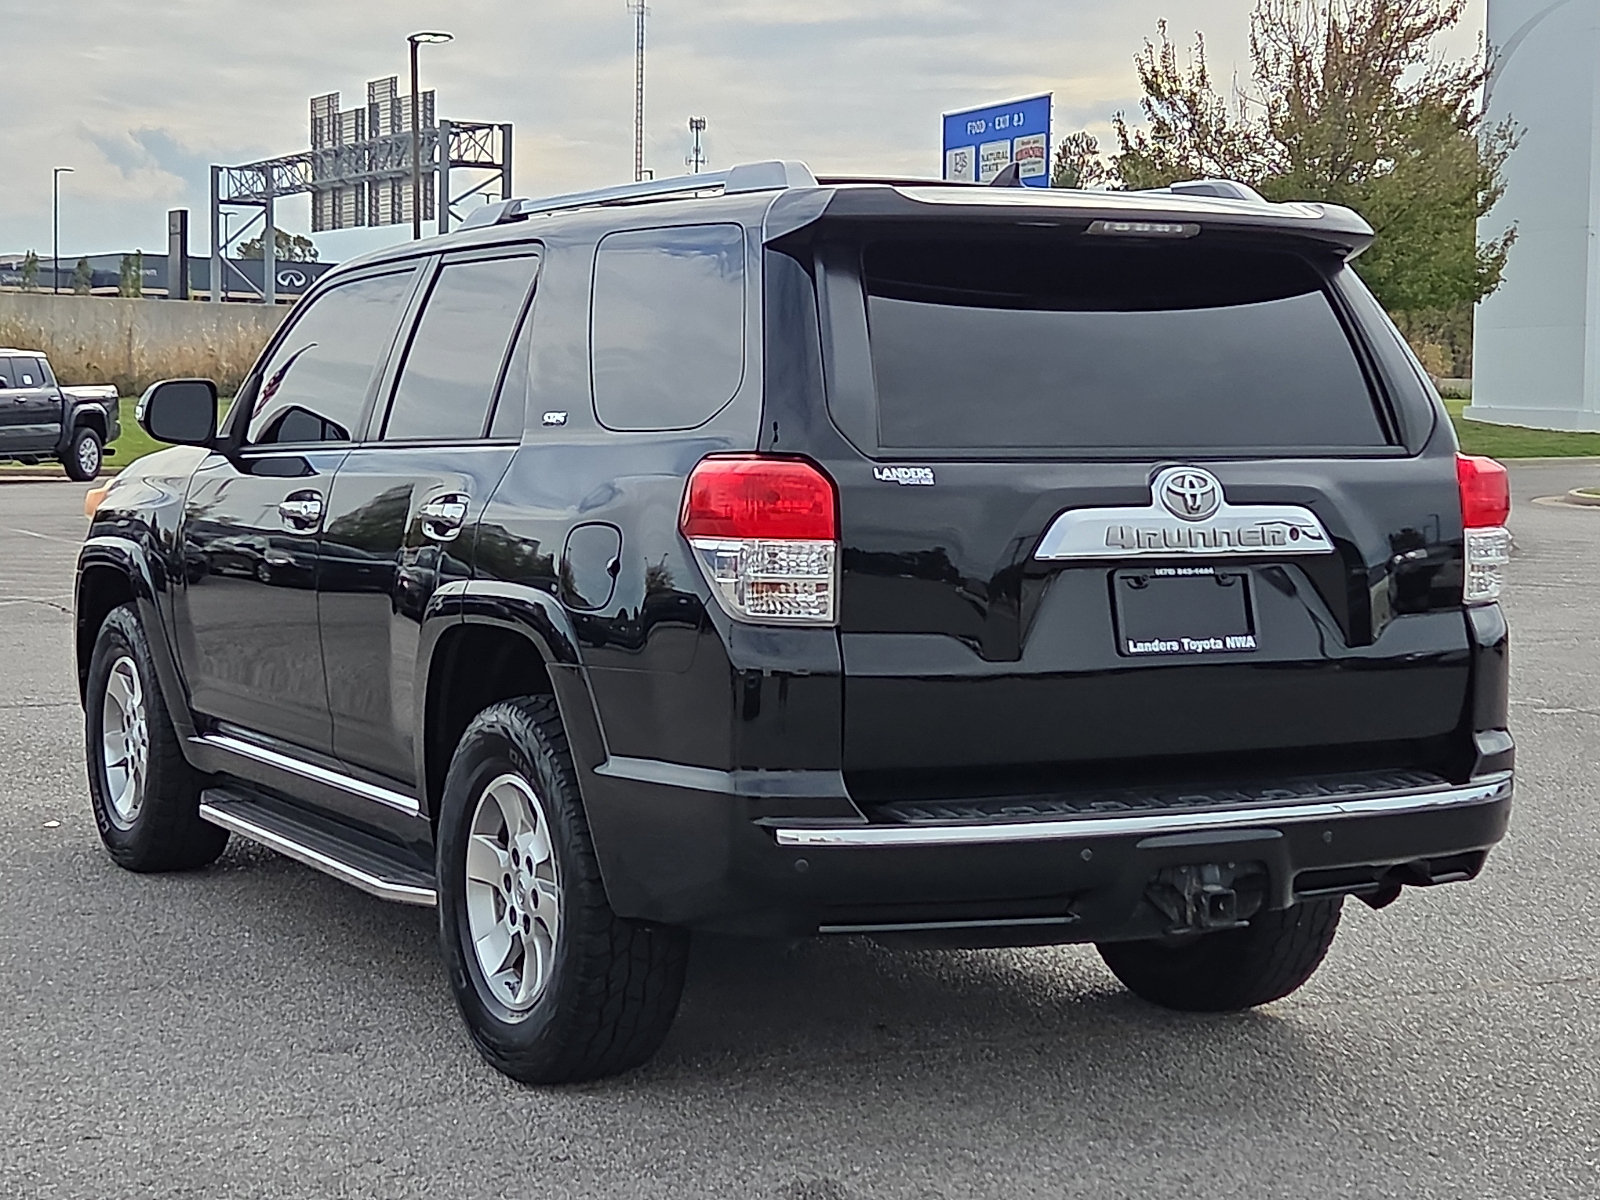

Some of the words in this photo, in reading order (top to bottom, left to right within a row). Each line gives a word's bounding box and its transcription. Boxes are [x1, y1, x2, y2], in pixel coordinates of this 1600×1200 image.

[873, 467, 934, 480] LANDERS
[1128, 639, 1180, 653] Landers
[1180, 637, 1224, 653] Toyota
[1225, 635, 1257, 649] NWA
